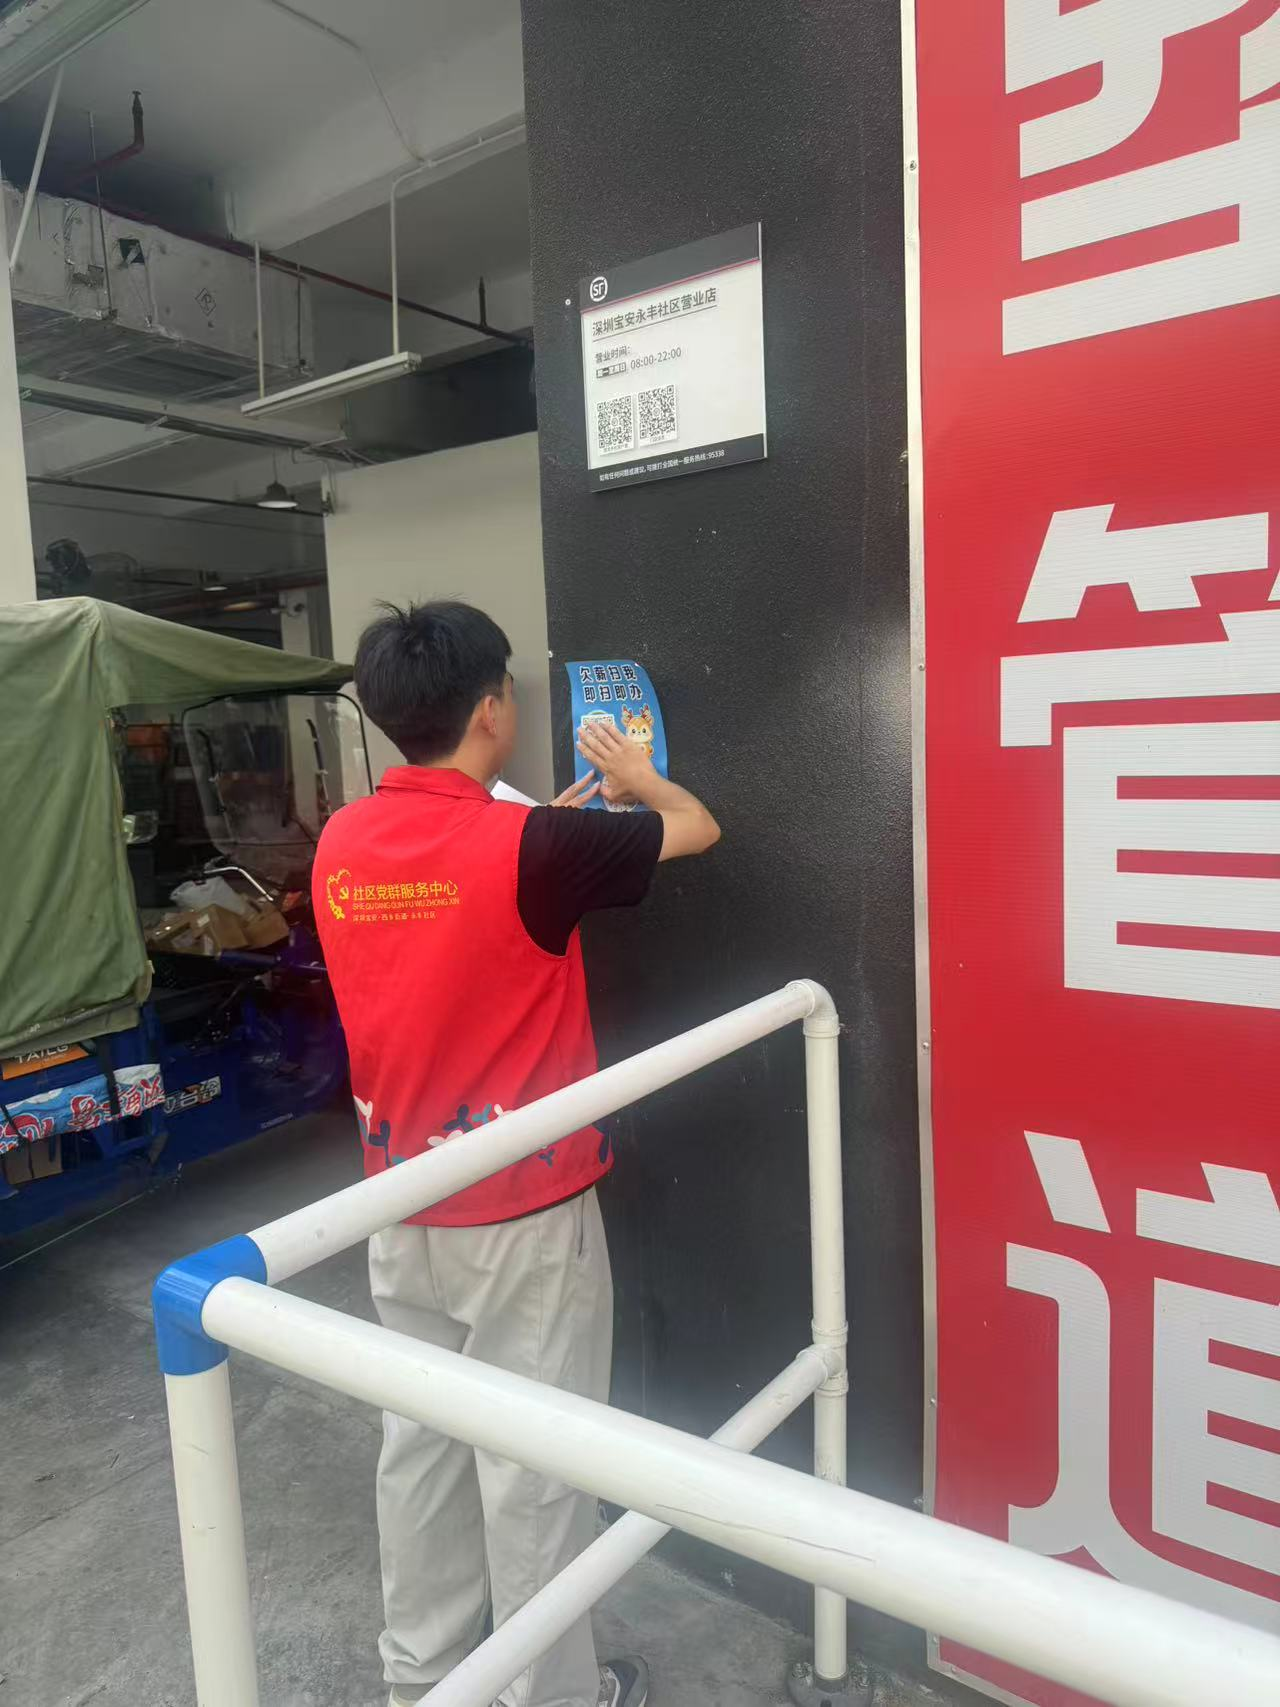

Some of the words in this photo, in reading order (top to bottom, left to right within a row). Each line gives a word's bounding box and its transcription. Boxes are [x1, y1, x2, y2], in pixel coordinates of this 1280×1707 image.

[592, 287, 717, 337] 深圳宝安永丰社区营业店
[630, 347, 682, 370] 08:00-22:00
[580, 665, 637, 683] 欠薪扫我
[583, 684, 643, 703] 即扫即办
[353, 880, 458, 900] 社区党群服务中心
